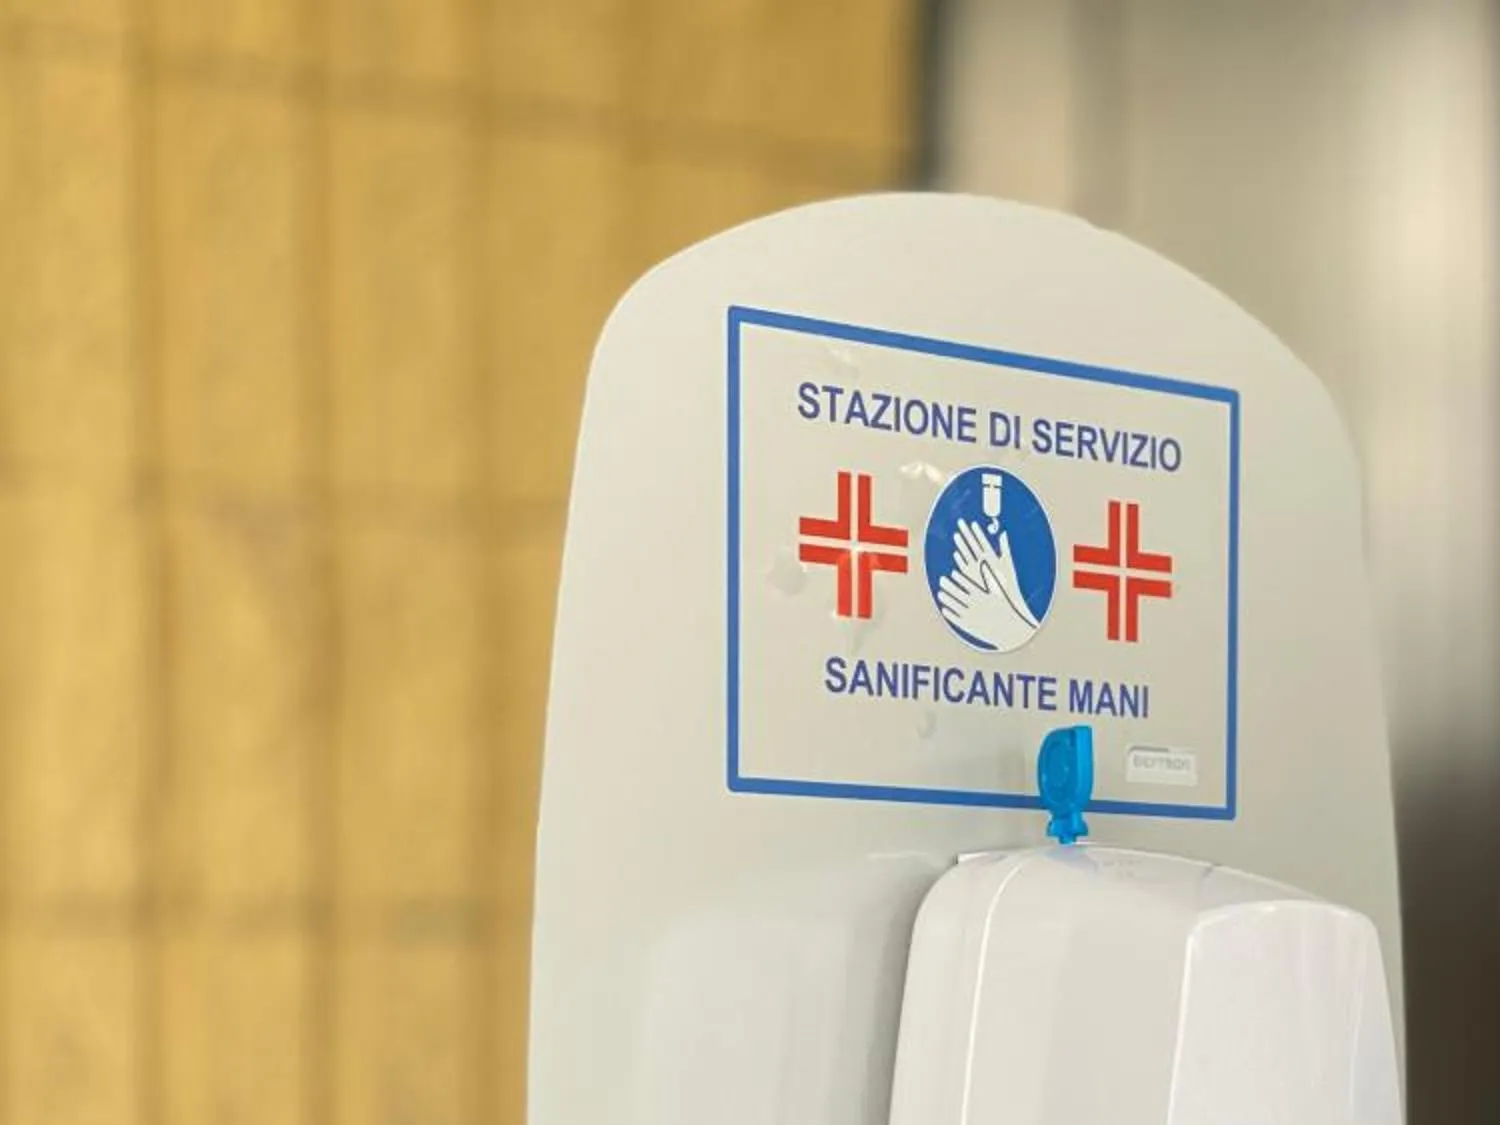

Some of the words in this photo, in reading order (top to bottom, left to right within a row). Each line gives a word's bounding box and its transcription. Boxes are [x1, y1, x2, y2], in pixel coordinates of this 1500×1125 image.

[798, 382, 977, 443] STAZIONE
[989, 411, 1020, 449] DI
[1032, 418, 1182, 472] SERVIZIO
[825, 656, 1057, 711] SANIFICANTE
[1069, 679, 1149, 718] MANI
